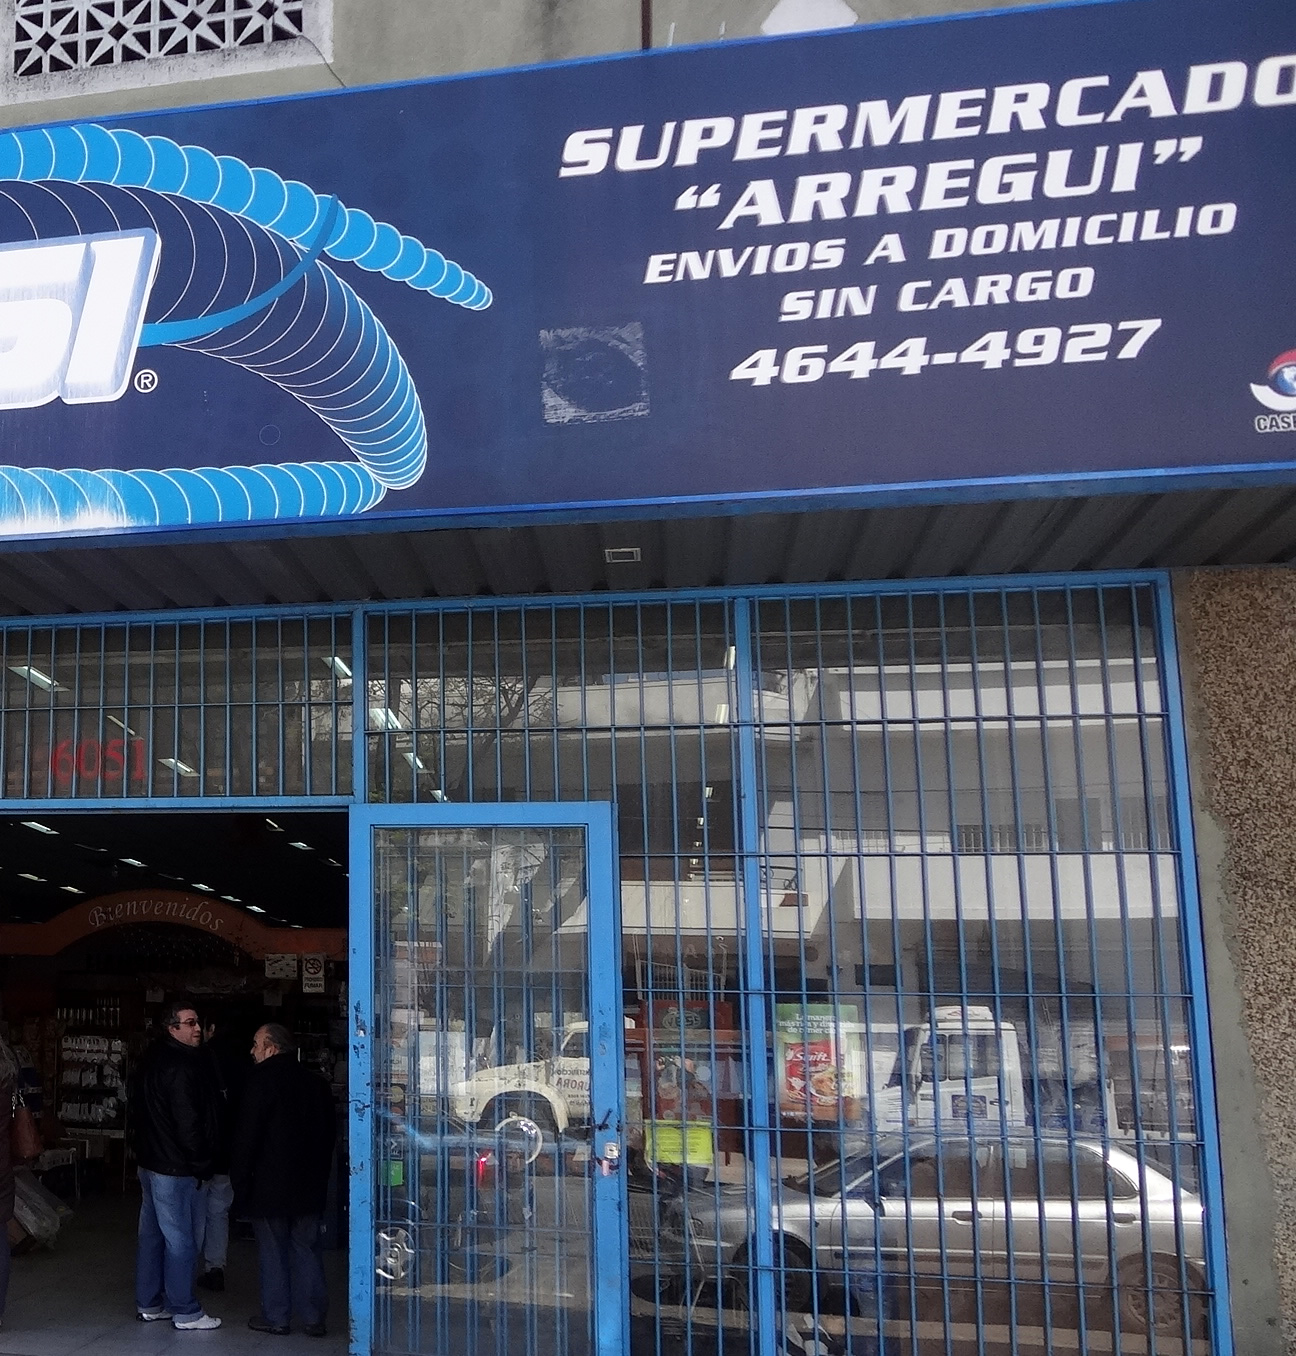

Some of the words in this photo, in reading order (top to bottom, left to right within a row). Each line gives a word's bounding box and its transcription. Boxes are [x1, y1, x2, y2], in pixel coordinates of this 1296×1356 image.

[559, 54, 1296, 178] SUPERMERCADO
[643, 238, 847, 284] ENVIOS
[863, 233, 908, 266] A
[928, 202, 1238, 261] DOMICILIO
[779, 284, 878, 322] SIN
[897, 266, 1096, 312] CARGO
[729, 318, 1163, 386] 4644-4927
[51, 739, 146, 786] 6051
[88, 897, 224, 931] Bienvenidos
